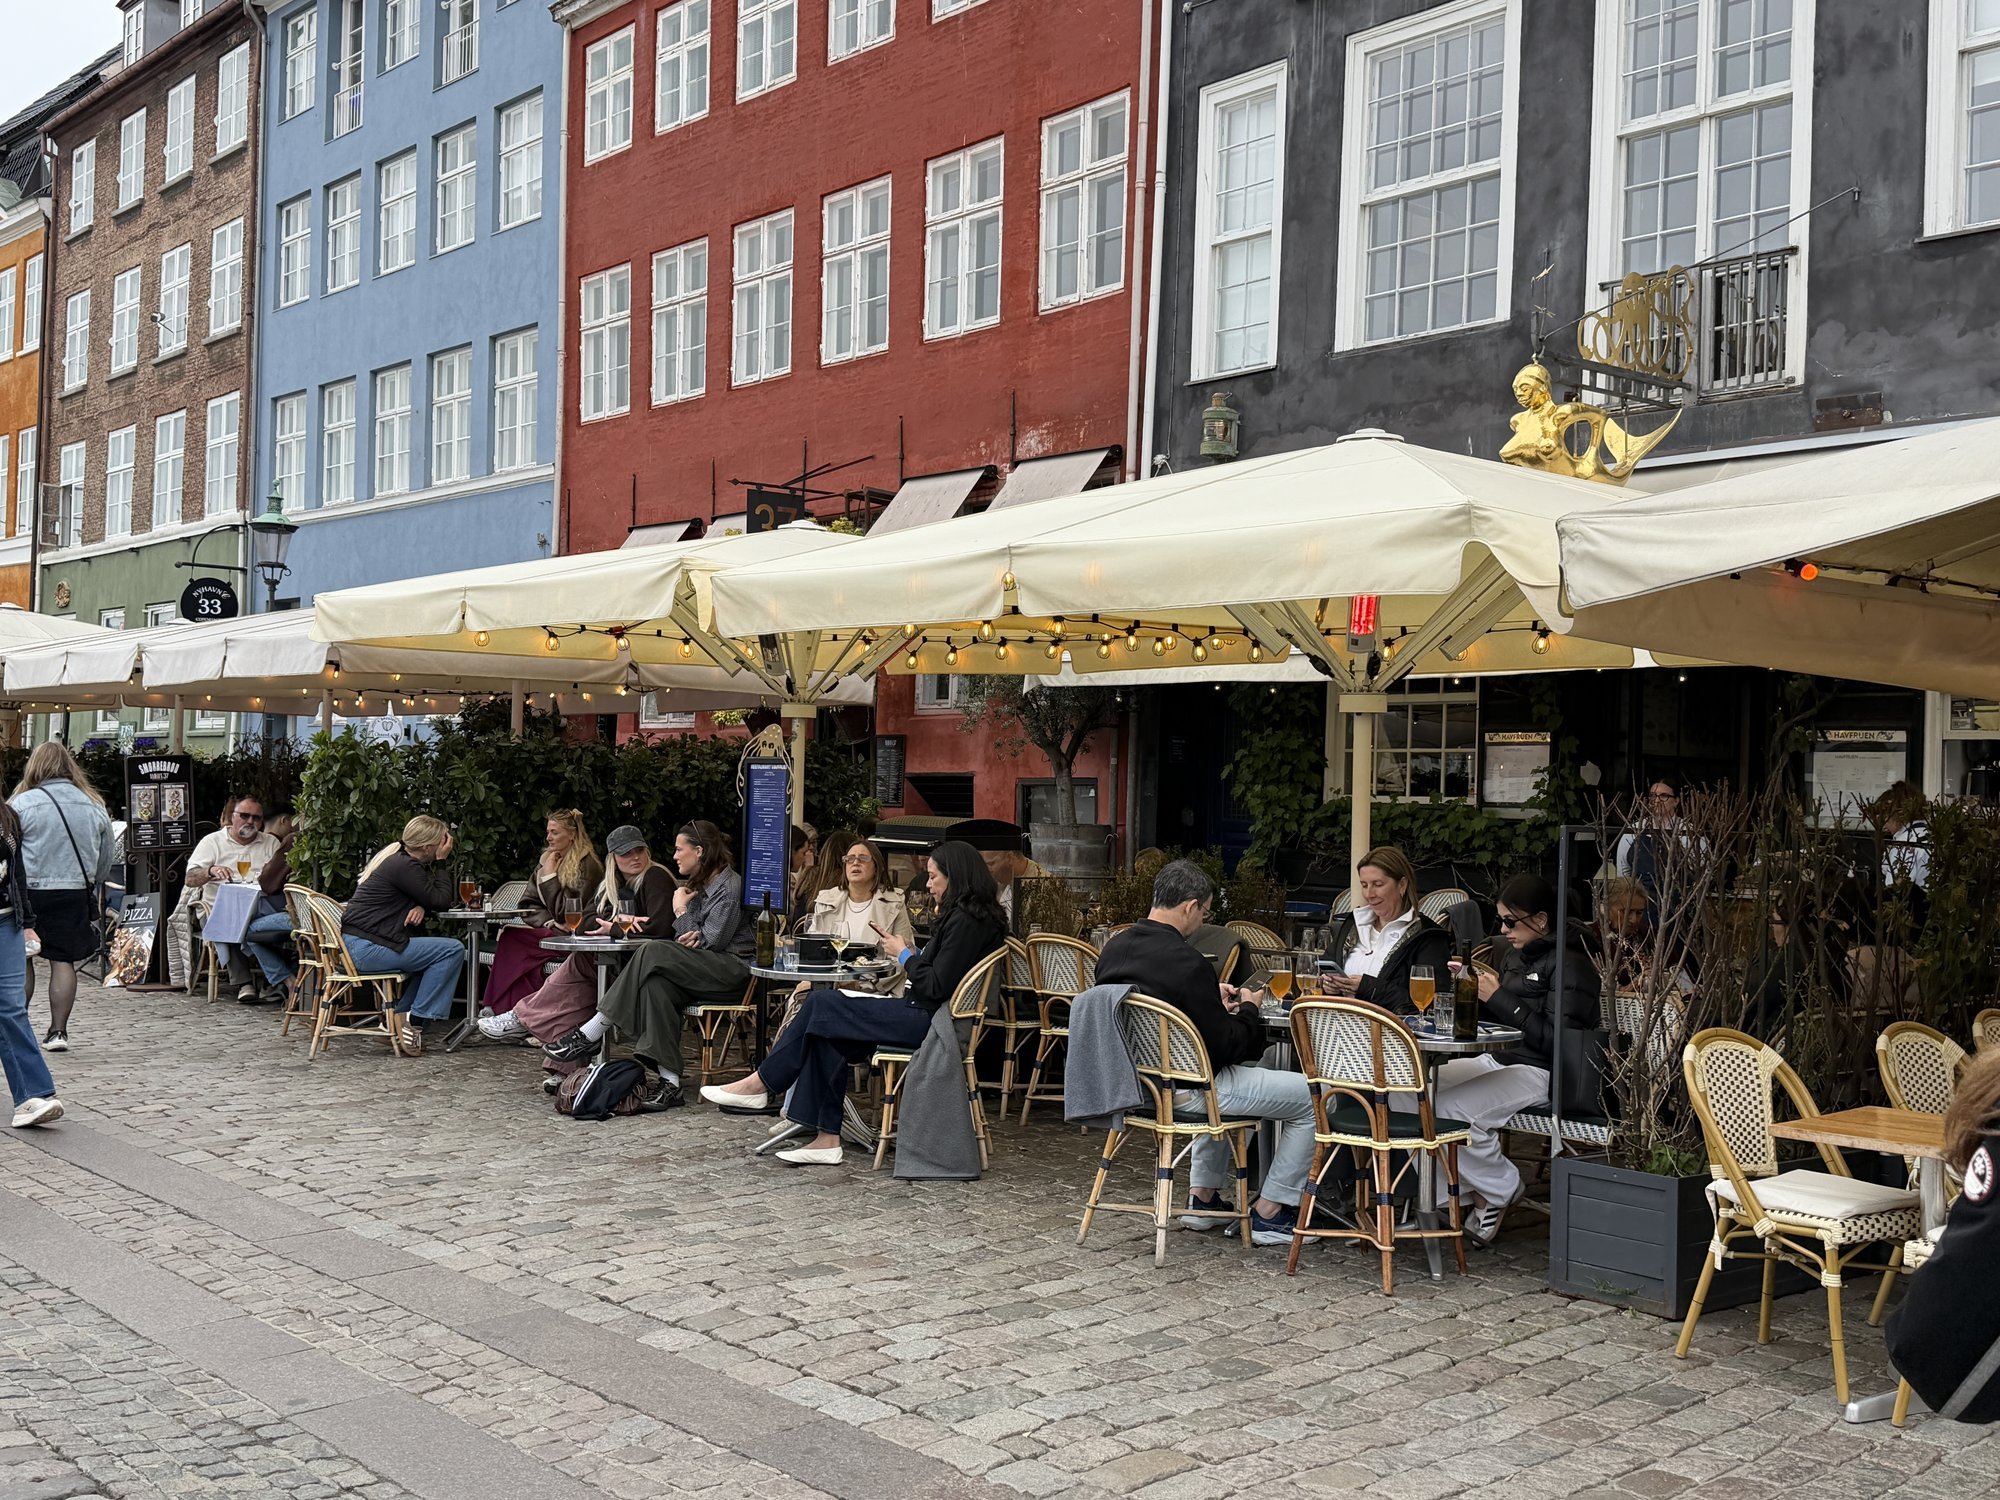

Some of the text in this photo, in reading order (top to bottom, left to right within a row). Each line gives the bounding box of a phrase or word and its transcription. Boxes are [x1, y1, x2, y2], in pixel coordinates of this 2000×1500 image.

[192, 586, 222, 599] NYHAVN
[198, 598, 222, 615] 33
[1834, 732, 1875, 740] HAVFRUEN
[122, 907, 153, 921] PIZZA
